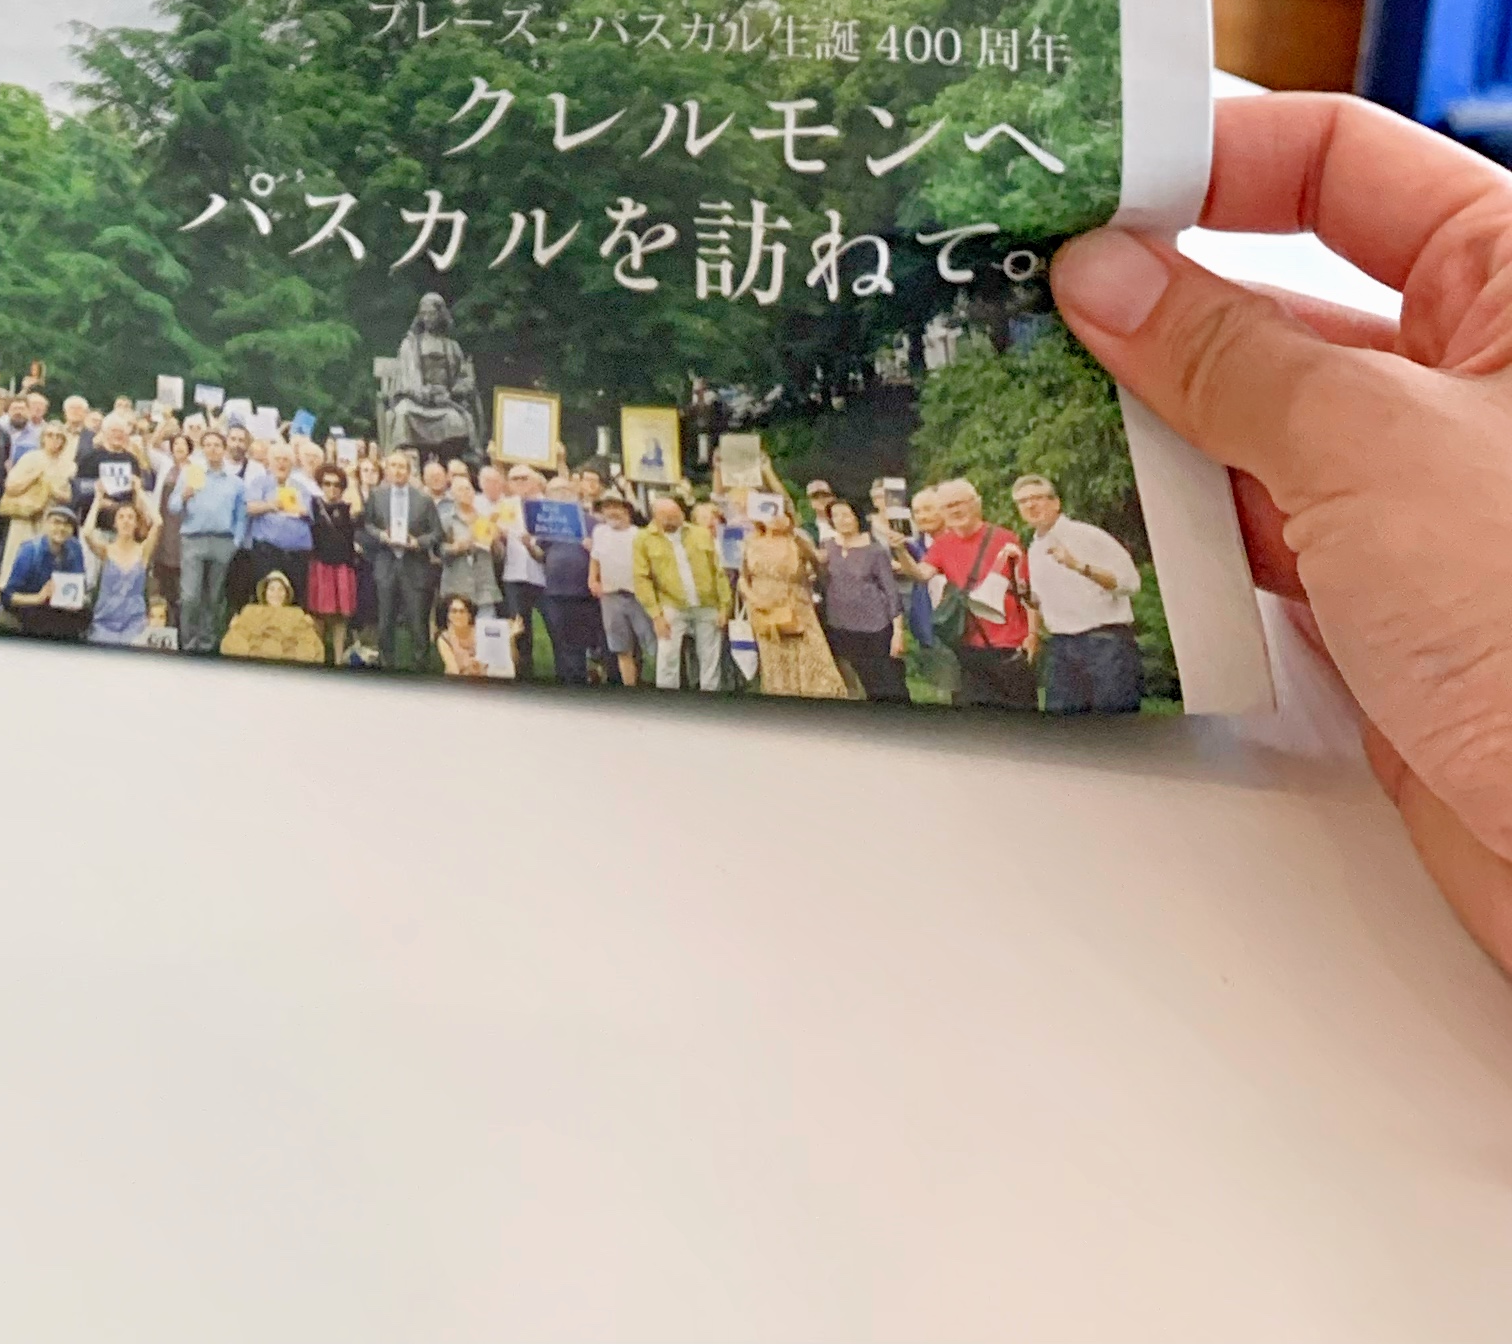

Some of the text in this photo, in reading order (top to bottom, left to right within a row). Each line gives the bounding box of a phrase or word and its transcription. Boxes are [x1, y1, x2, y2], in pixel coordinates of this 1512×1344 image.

[441, 75, 1068, 178] クレルモンへ
[177, 171, 1040, 308] パスカルを訪ねて。
